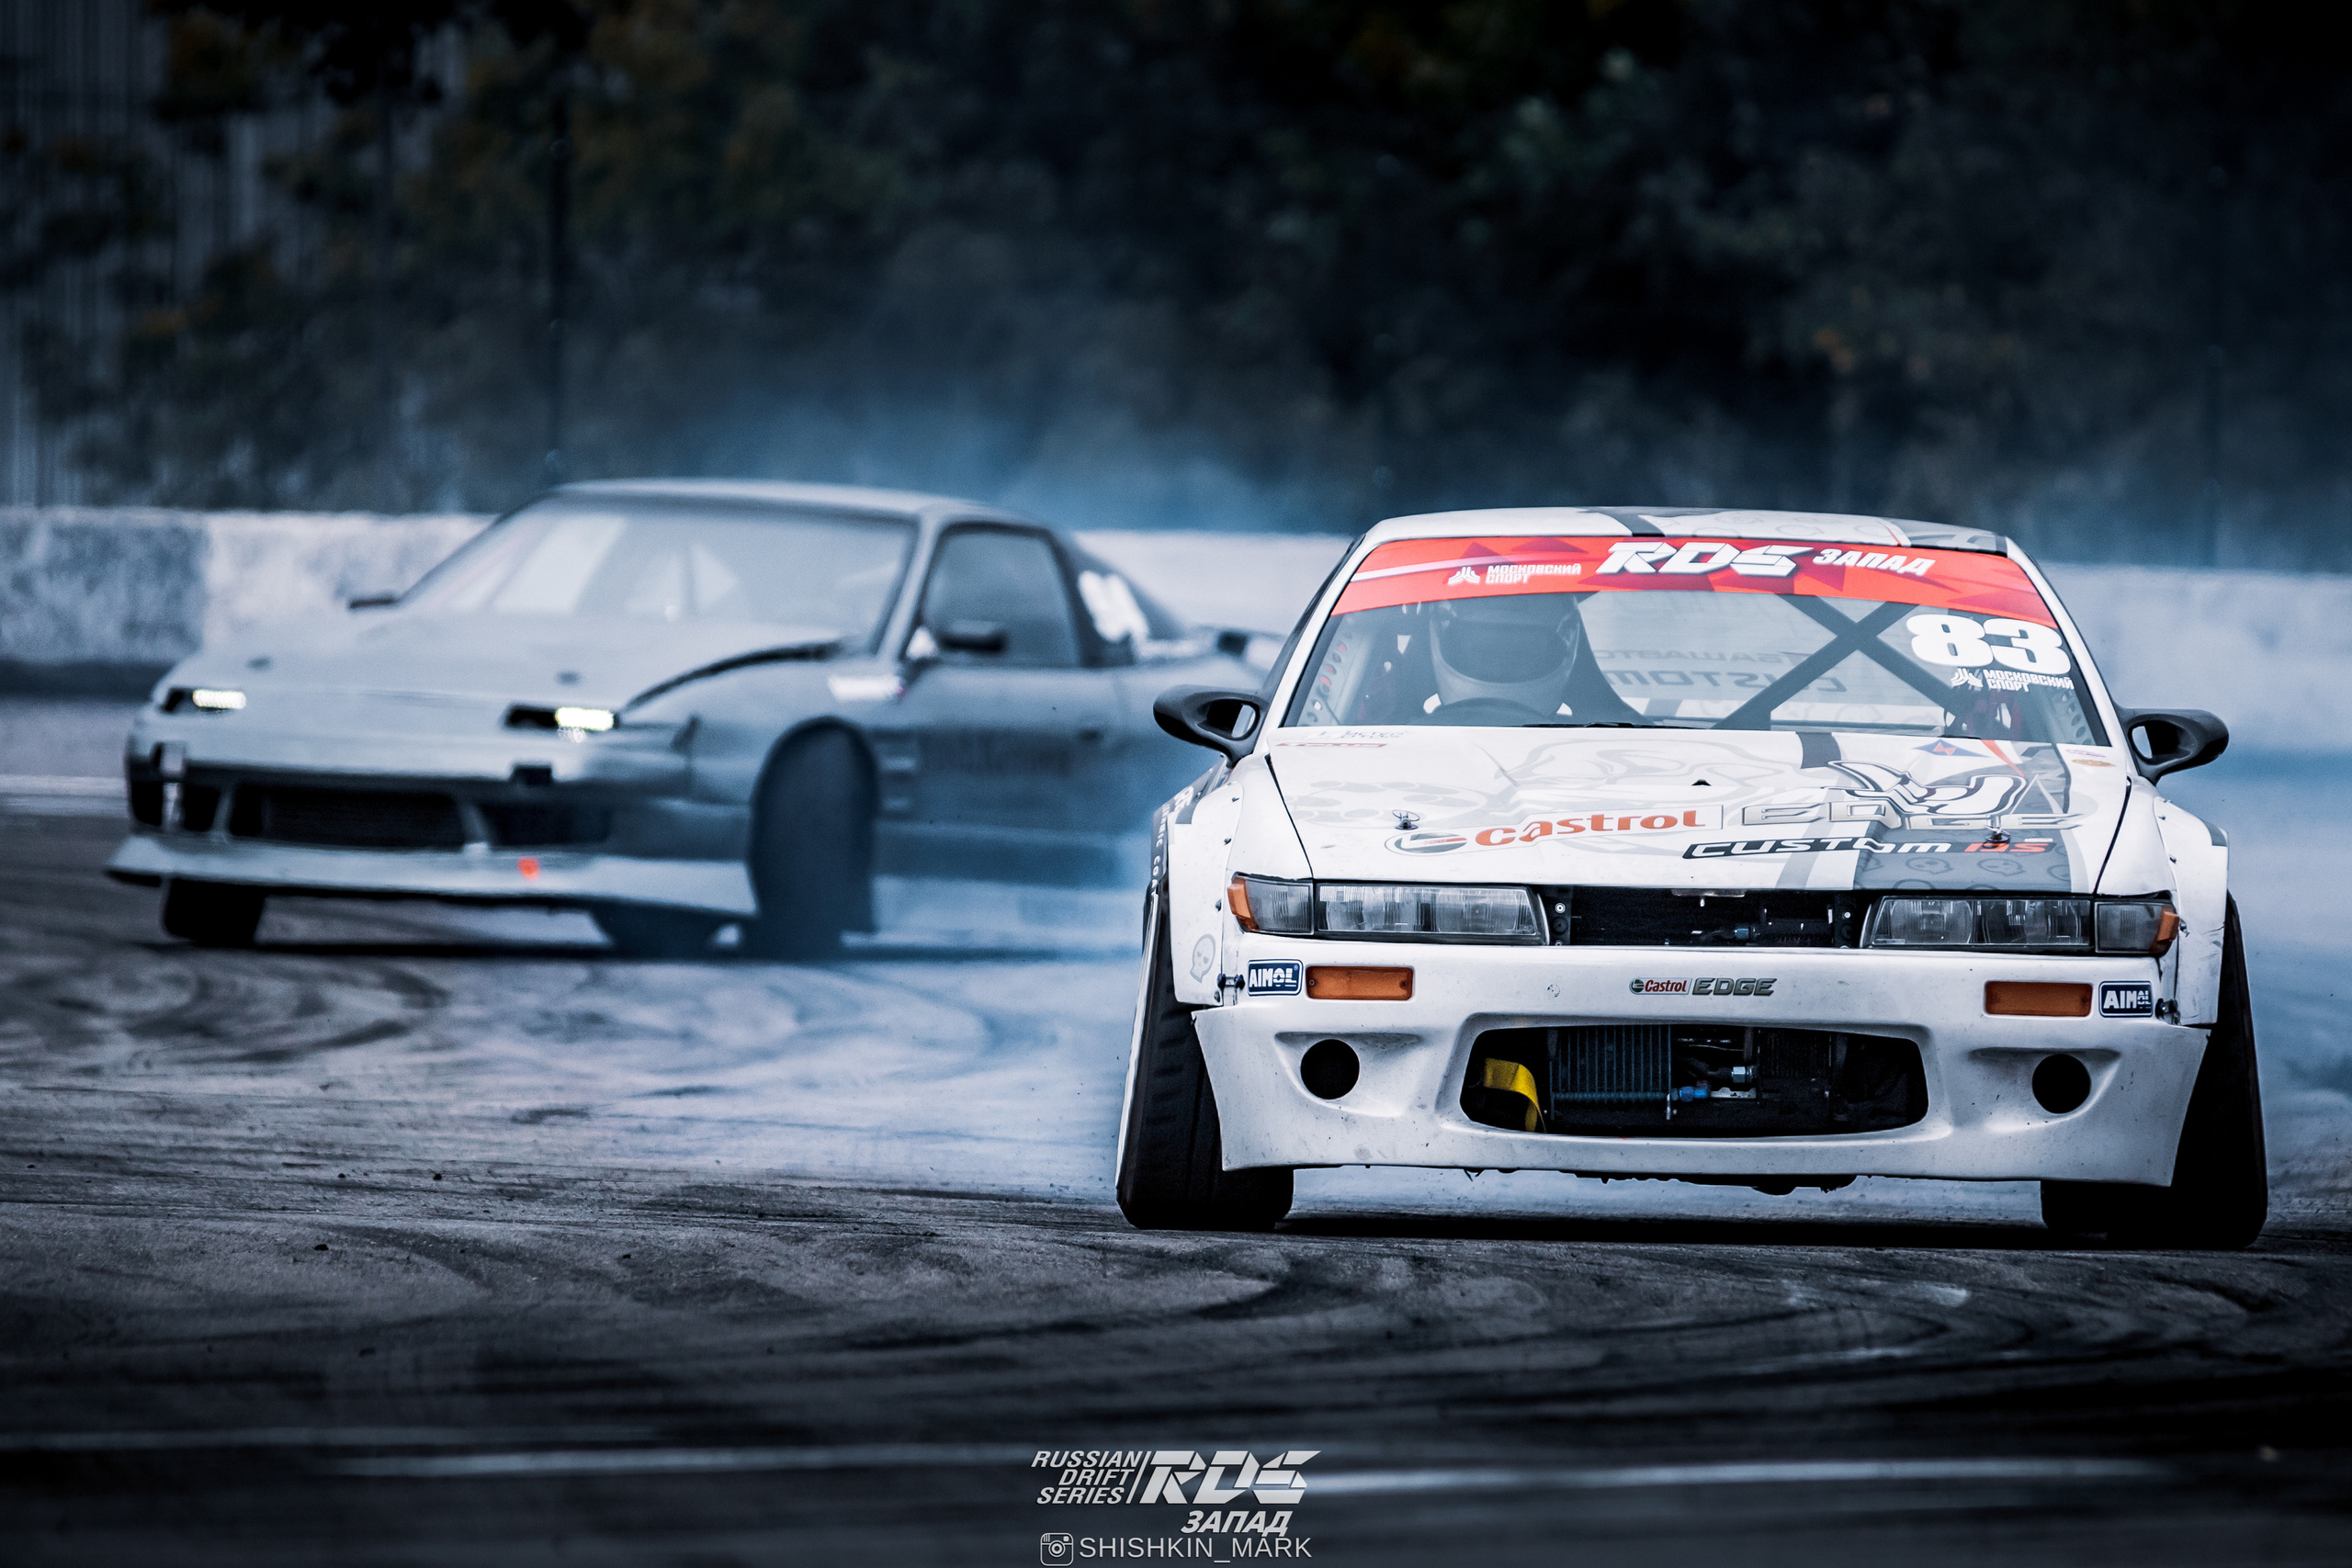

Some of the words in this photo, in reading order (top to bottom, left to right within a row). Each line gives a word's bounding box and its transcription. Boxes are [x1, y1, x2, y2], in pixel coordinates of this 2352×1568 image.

[1487, 563, 1582, 576] МОСКОВСКИЙ
[1596, 542, 1814, 577] RDS
[1813, 548, 1936, 577] ЗАПАД
[1485, 573, 1530, 584] СПОРТ
[1906, 614, 2072, 675] 83
[1983, 669, 2075, 690] МОСКОВСКИЙ
[1987, 679, 2029, 692] СПОРТ
[1476, 809, 1706, 847] Castrol
[1742, 802, 2084, 830] EDGE
[1690, 837, 1951, 857] CUSTOM
[1250, 967, 1297, 987] AIMOL
[1645, 979, 1687, 992] Castrol
[1692, 977, 1778, 996] EDGE
[2103, 989, 2152, 1010] AIMOL
